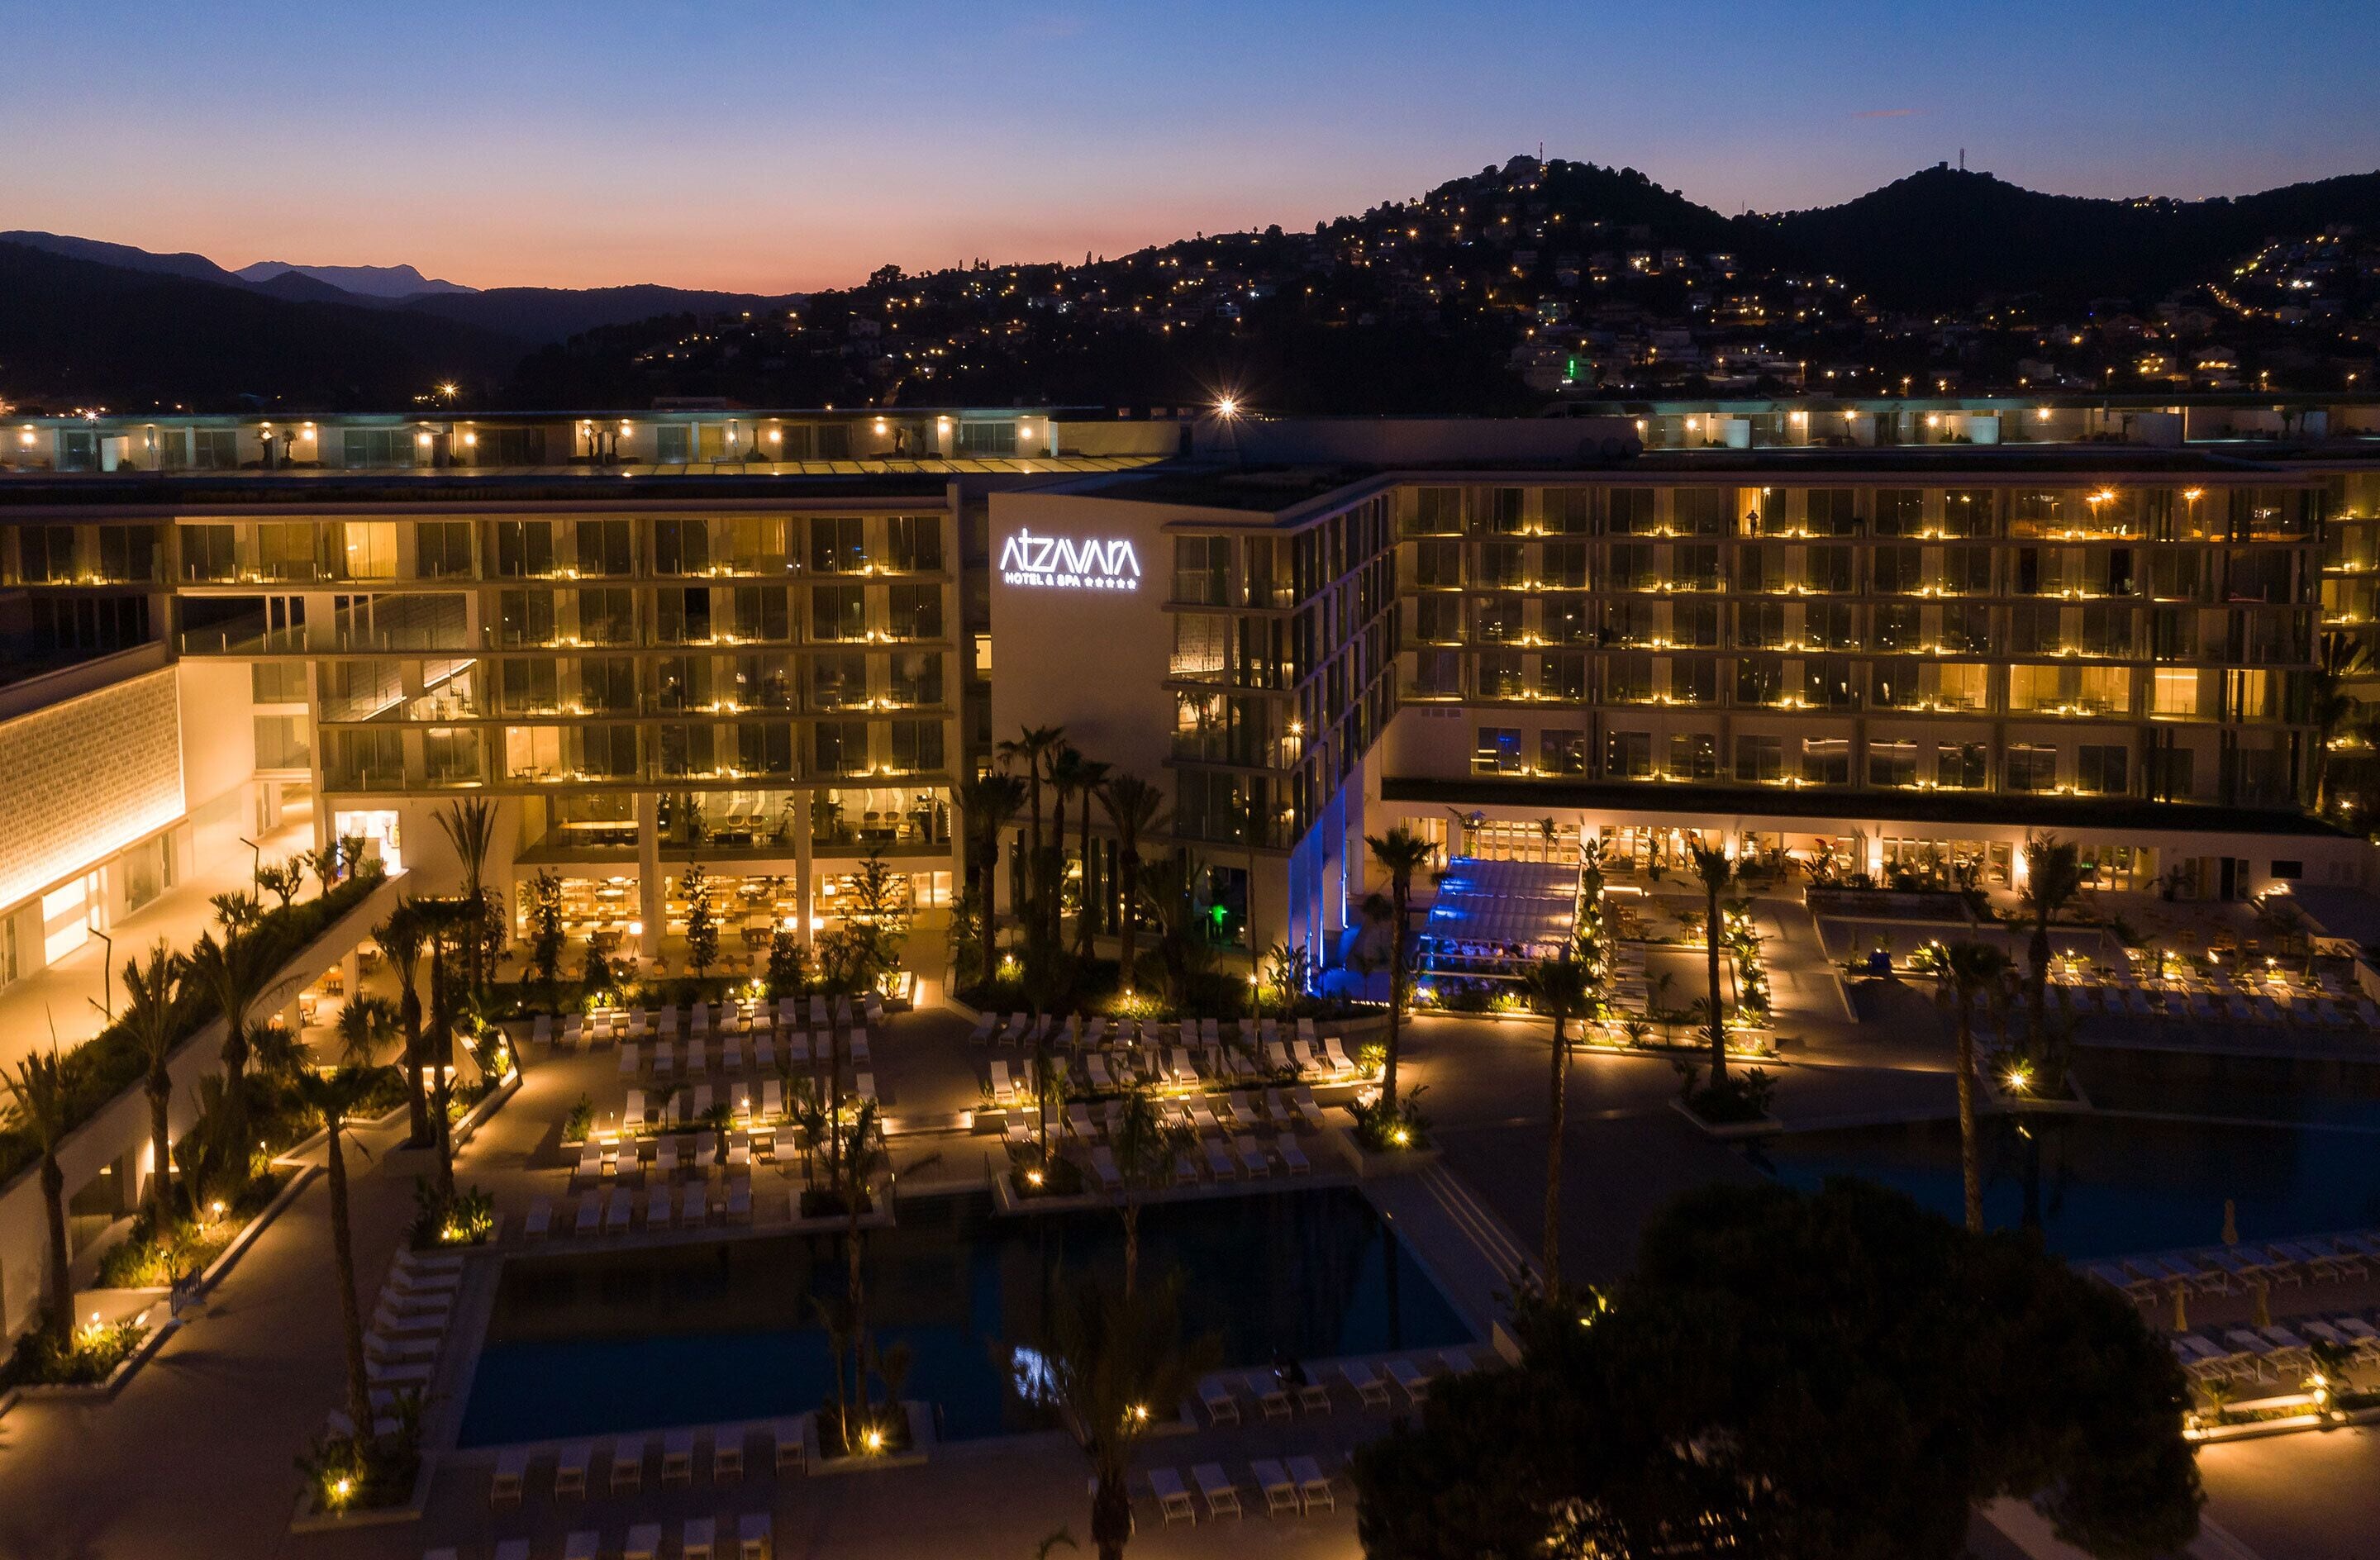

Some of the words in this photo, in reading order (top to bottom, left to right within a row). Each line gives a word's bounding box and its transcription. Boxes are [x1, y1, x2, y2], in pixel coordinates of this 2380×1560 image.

[1005, 572, 1044, 586] HOTEL
[1045, 573, 1054, 586] &
[1056, 574, 1081, 587] SPA
